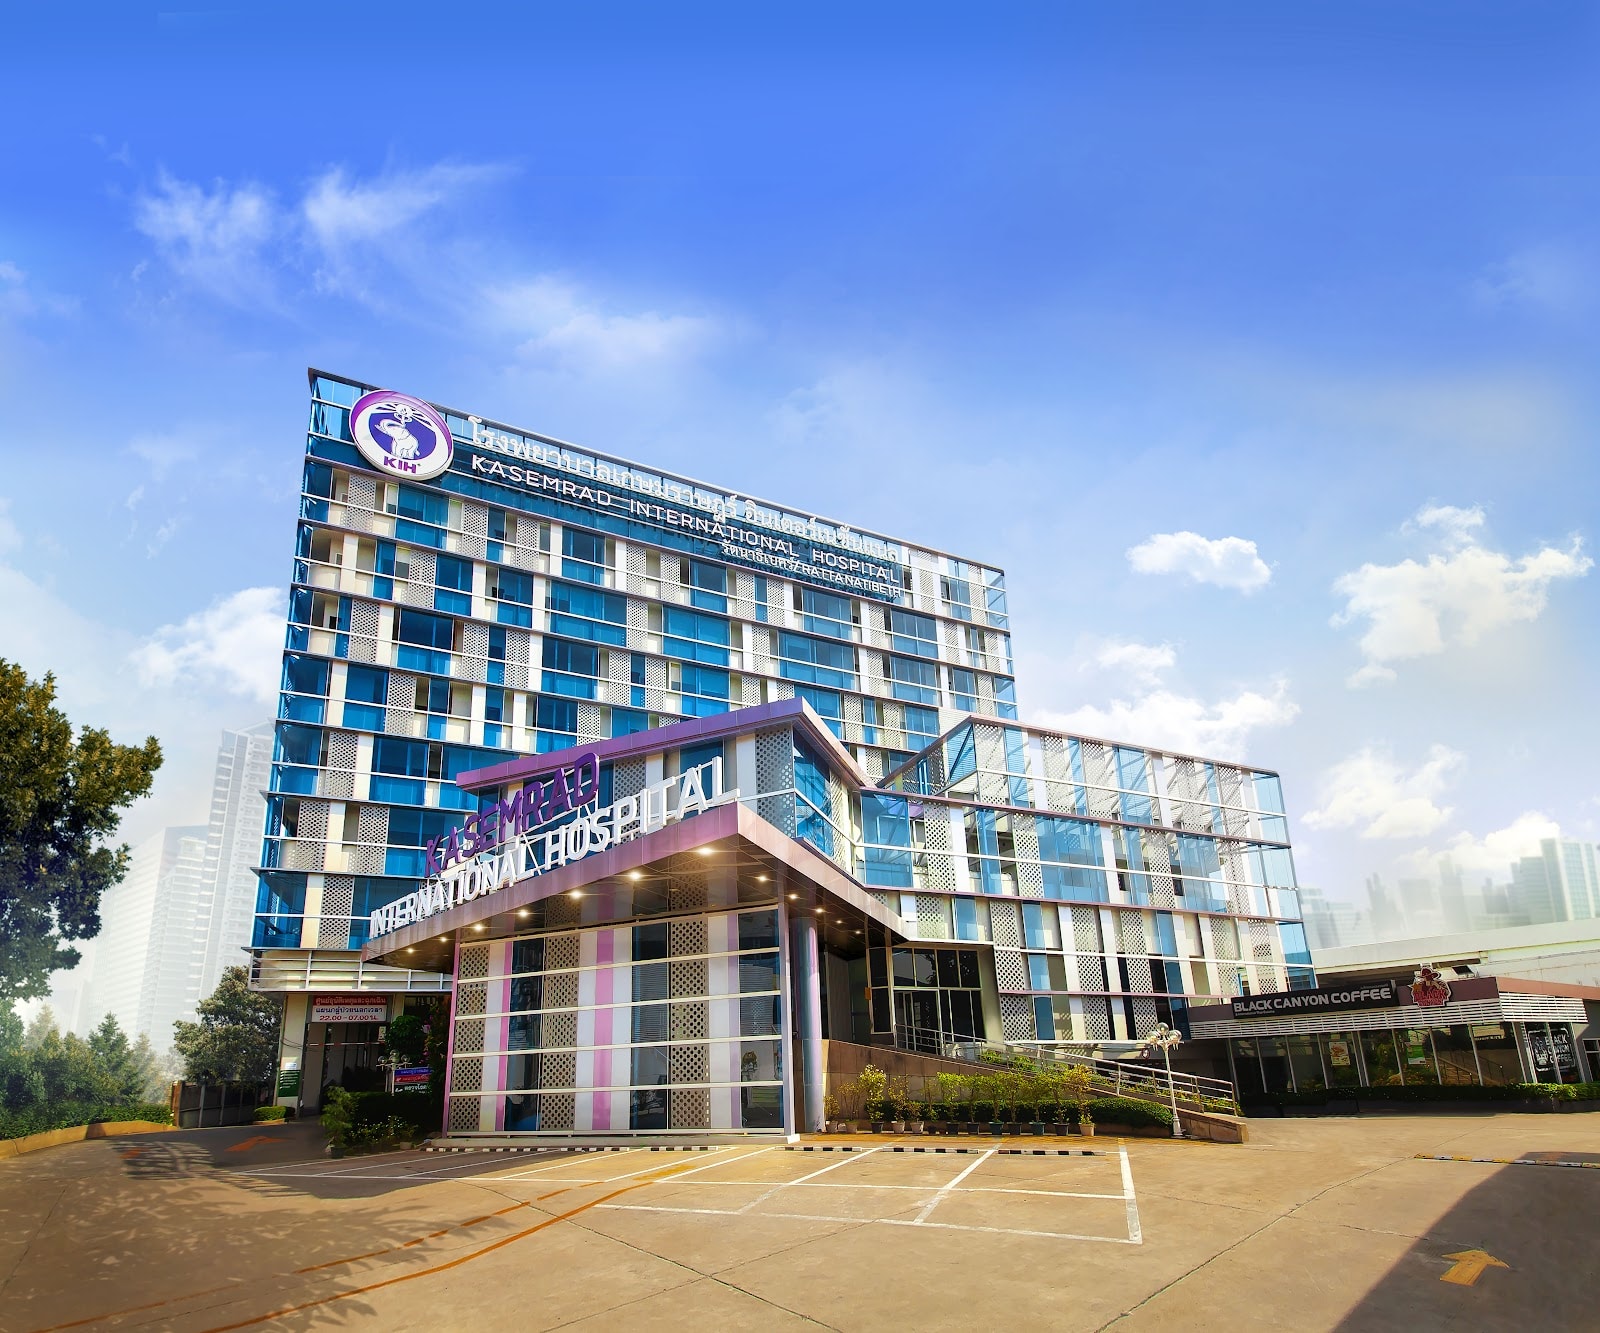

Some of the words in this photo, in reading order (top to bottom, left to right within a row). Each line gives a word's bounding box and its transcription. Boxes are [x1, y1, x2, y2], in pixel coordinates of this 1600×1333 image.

[383, 455, 417, 474] KIH
[472, 454, 611, 506] KASEMRAD
[629, 499, 800, 558] INTERNATIONAL
[812, 548, 900, 584] HOSPITAL
[370, 843, 538, 939] INTERNATIONAL
[544, 756, 741, 870] HOSPITAL
[425, 752, 601, 877] KASEMRAD
[1233, 999, 1273, 1013] BLACK
[1273, 993, 1330, 1009] CANYON
[1330, 987, 1392, 1003] COFFEE
